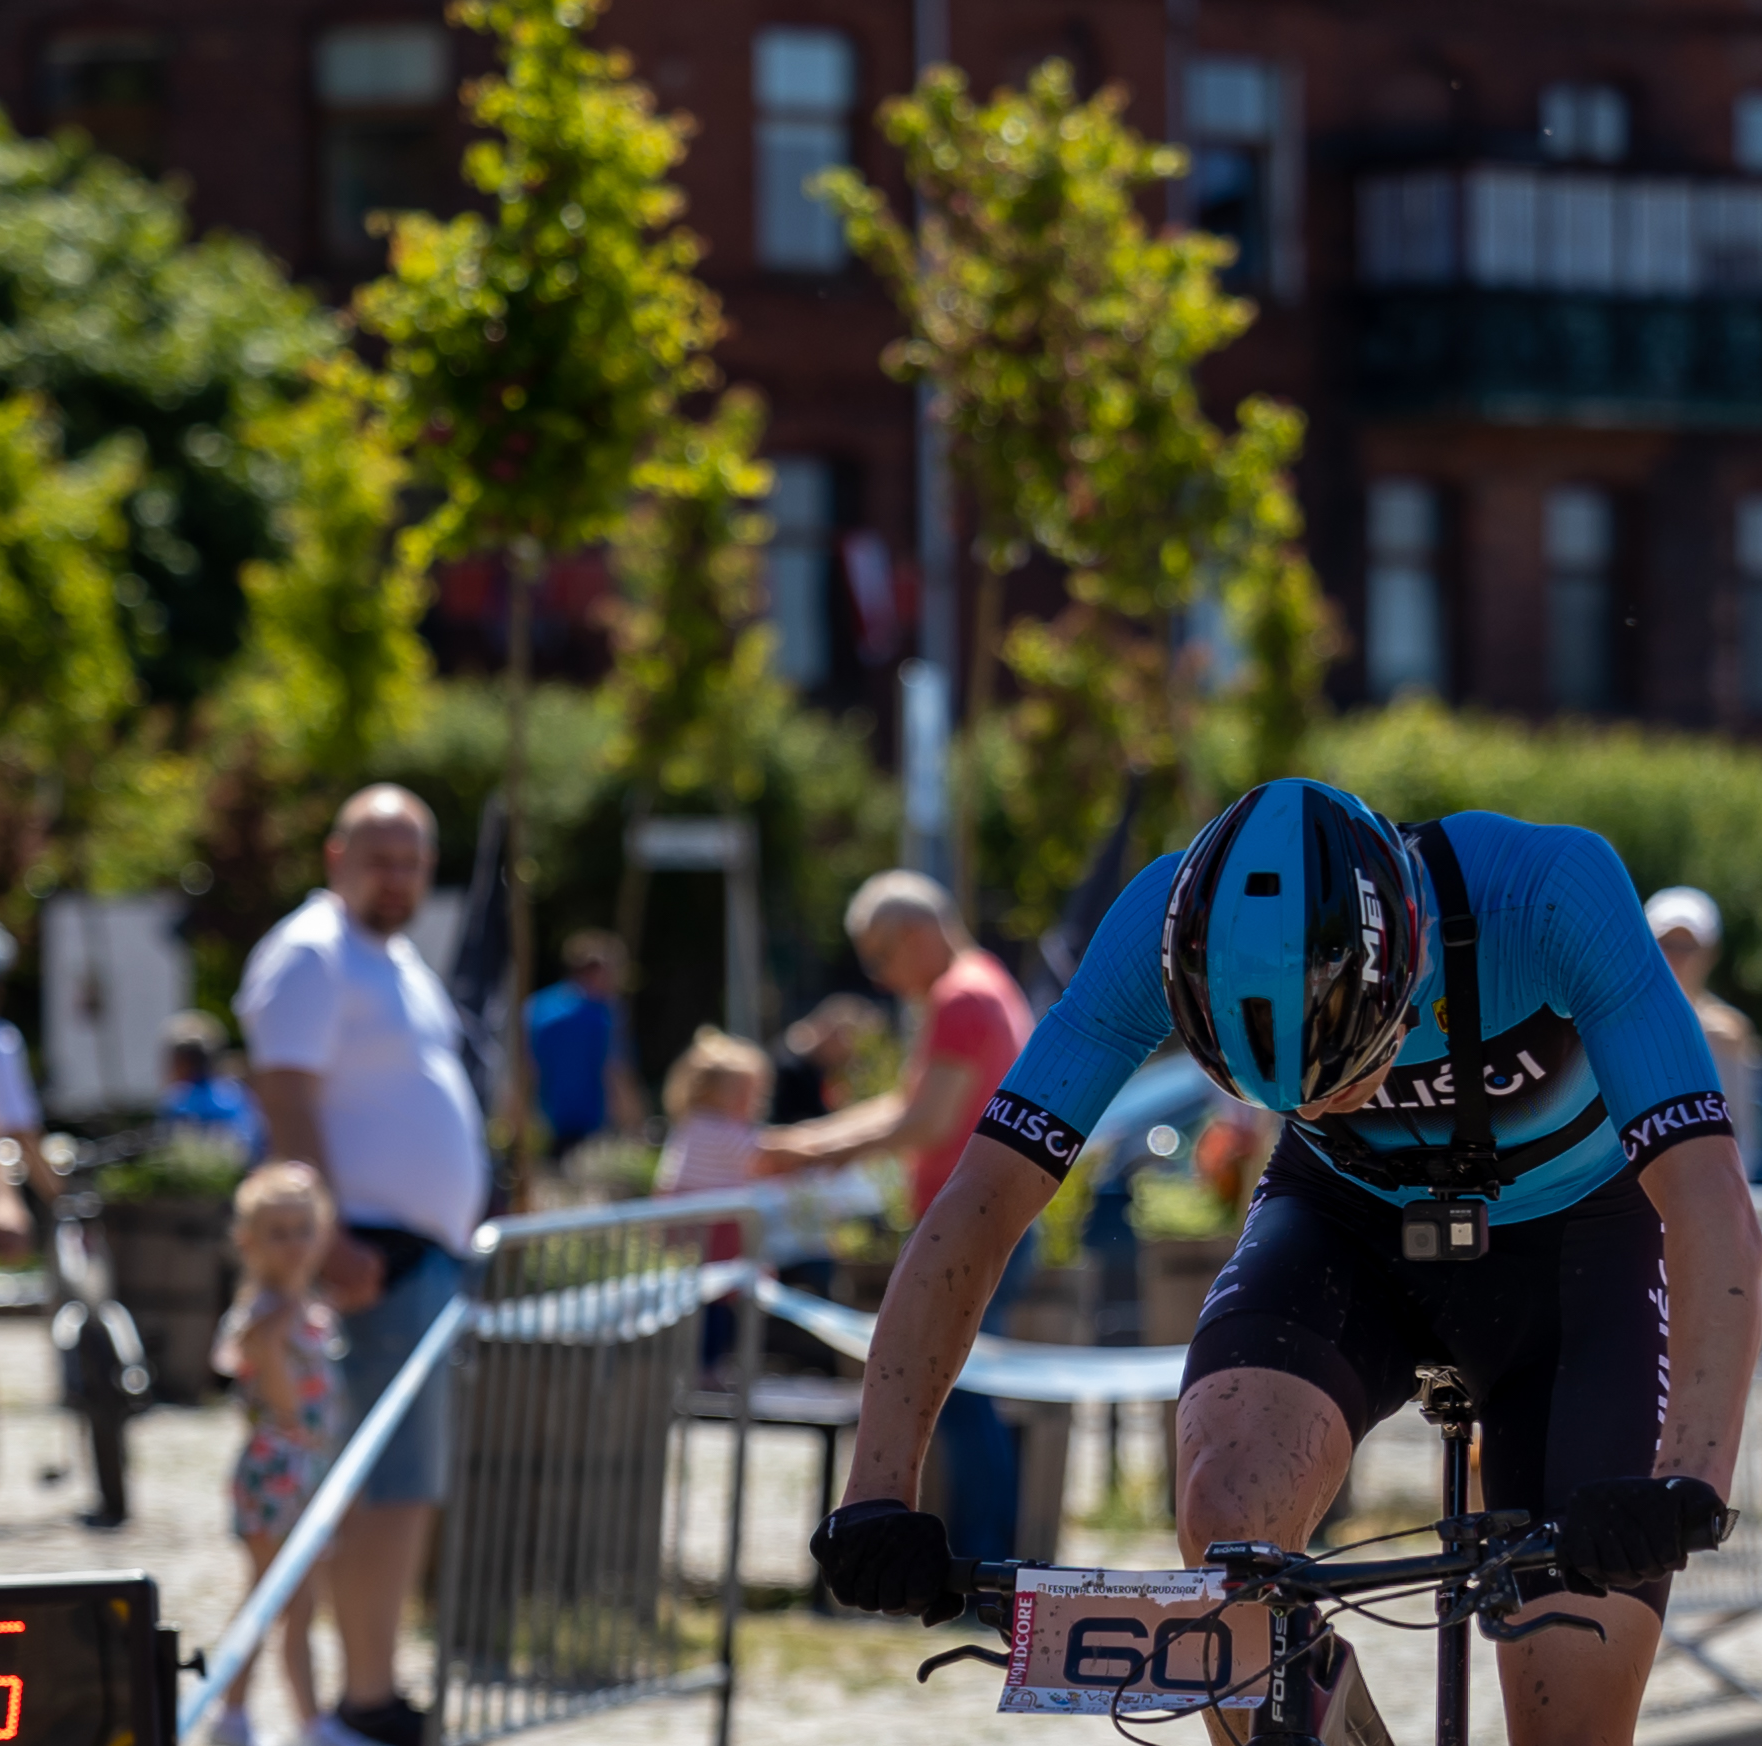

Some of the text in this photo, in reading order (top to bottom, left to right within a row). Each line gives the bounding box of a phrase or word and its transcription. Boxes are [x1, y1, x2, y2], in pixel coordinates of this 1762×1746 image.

[1353, 866, 1384, 985] MET
[980, 1096, 1081, 1167] KLIŚCI
[1047, 1584, 1092, 1595] FESTIWAL
[1092, 1584, 1145, 1595] ROWEROWY
[1008, 1597, 1034, 1686] HARDCORE
[1063, 1617, 1233, 1692] 60
[1271, 1614, 1289, 1723] FOCUS
